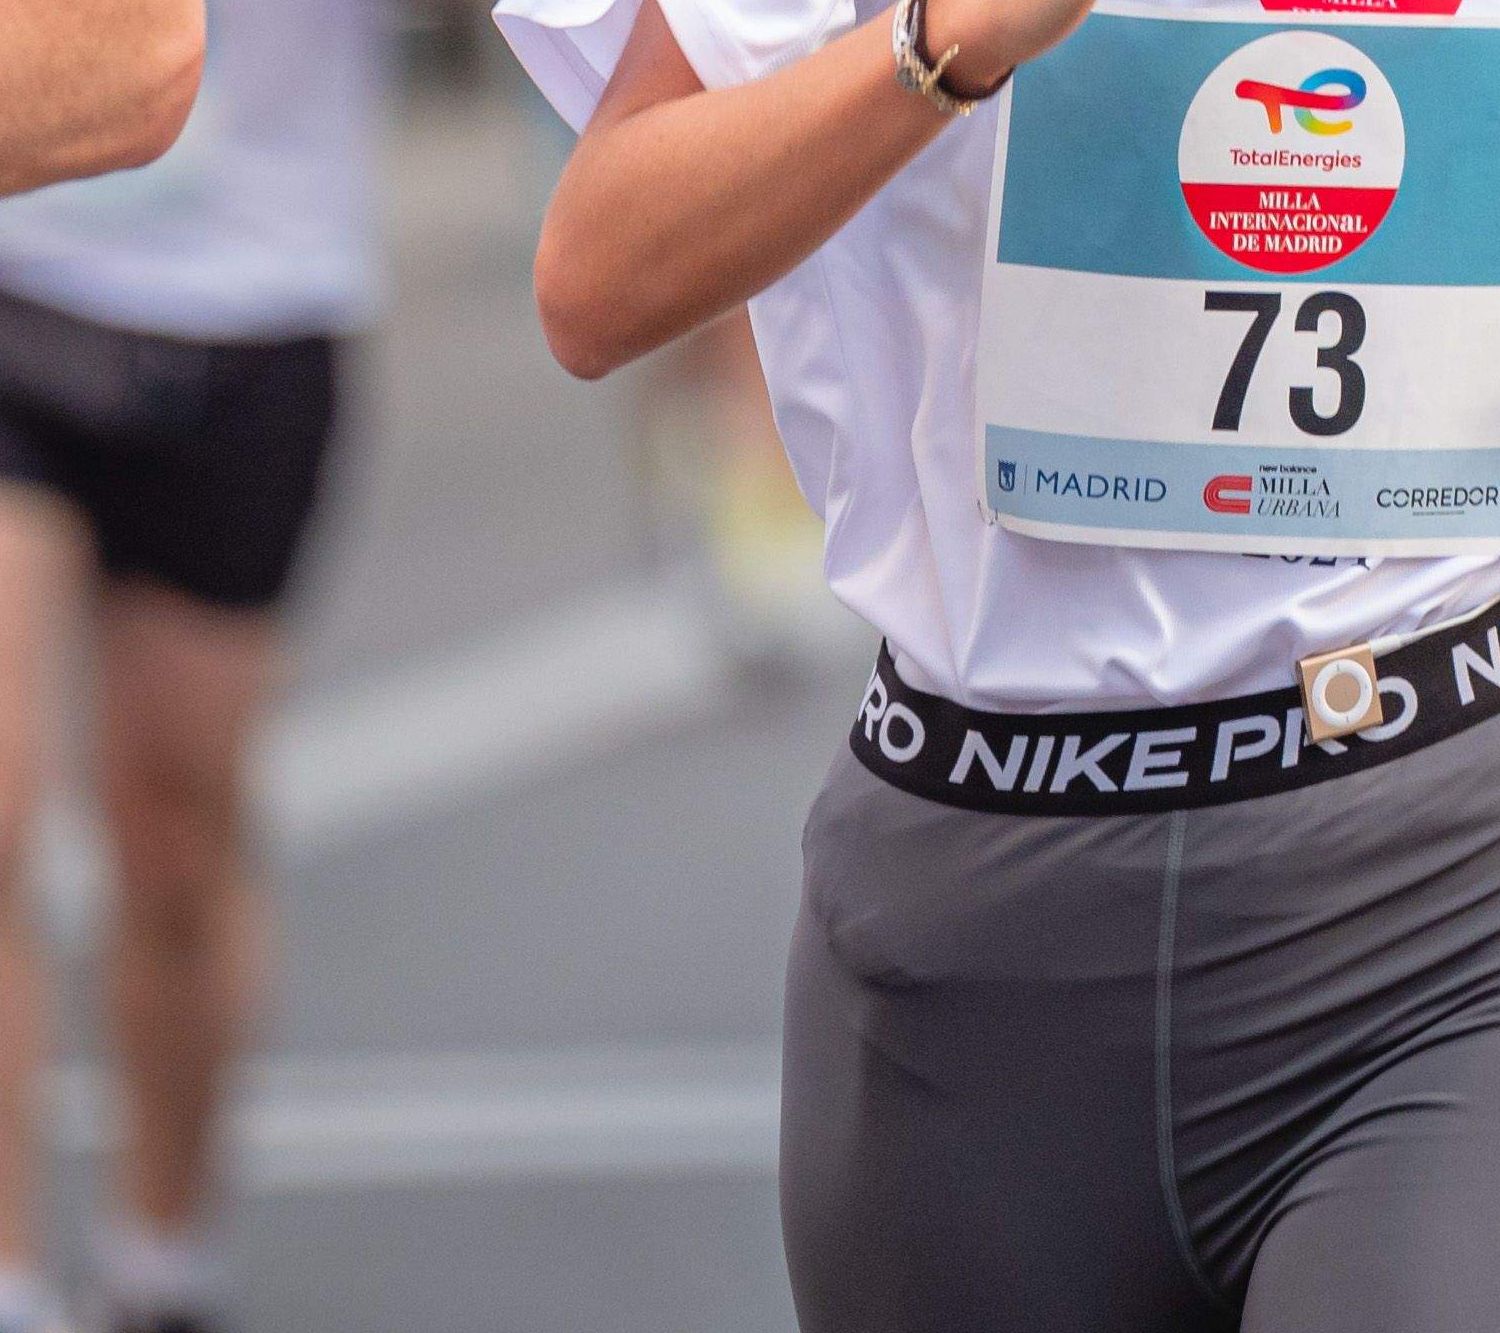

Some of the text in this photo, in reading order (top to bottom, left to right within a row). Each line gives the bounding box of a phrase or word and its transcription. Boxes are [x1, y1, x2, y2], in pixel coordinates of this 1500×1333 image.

[1230, 149, 1362, 171] TotalEnergies
[1258, 191, 1321, 210] MILLA
[1232, 233, 1343, 254] DE MADRID
[1204, 290, 1367, 436] 73
[1036, 469, 1168, 503] MADRID
[1259, 477, 1331, 496] MILLA
[1256, 498, 1341, 519] URBANA
[858, 661, 926, 763] RO
[949, 729, 1197, 793] NIKE
